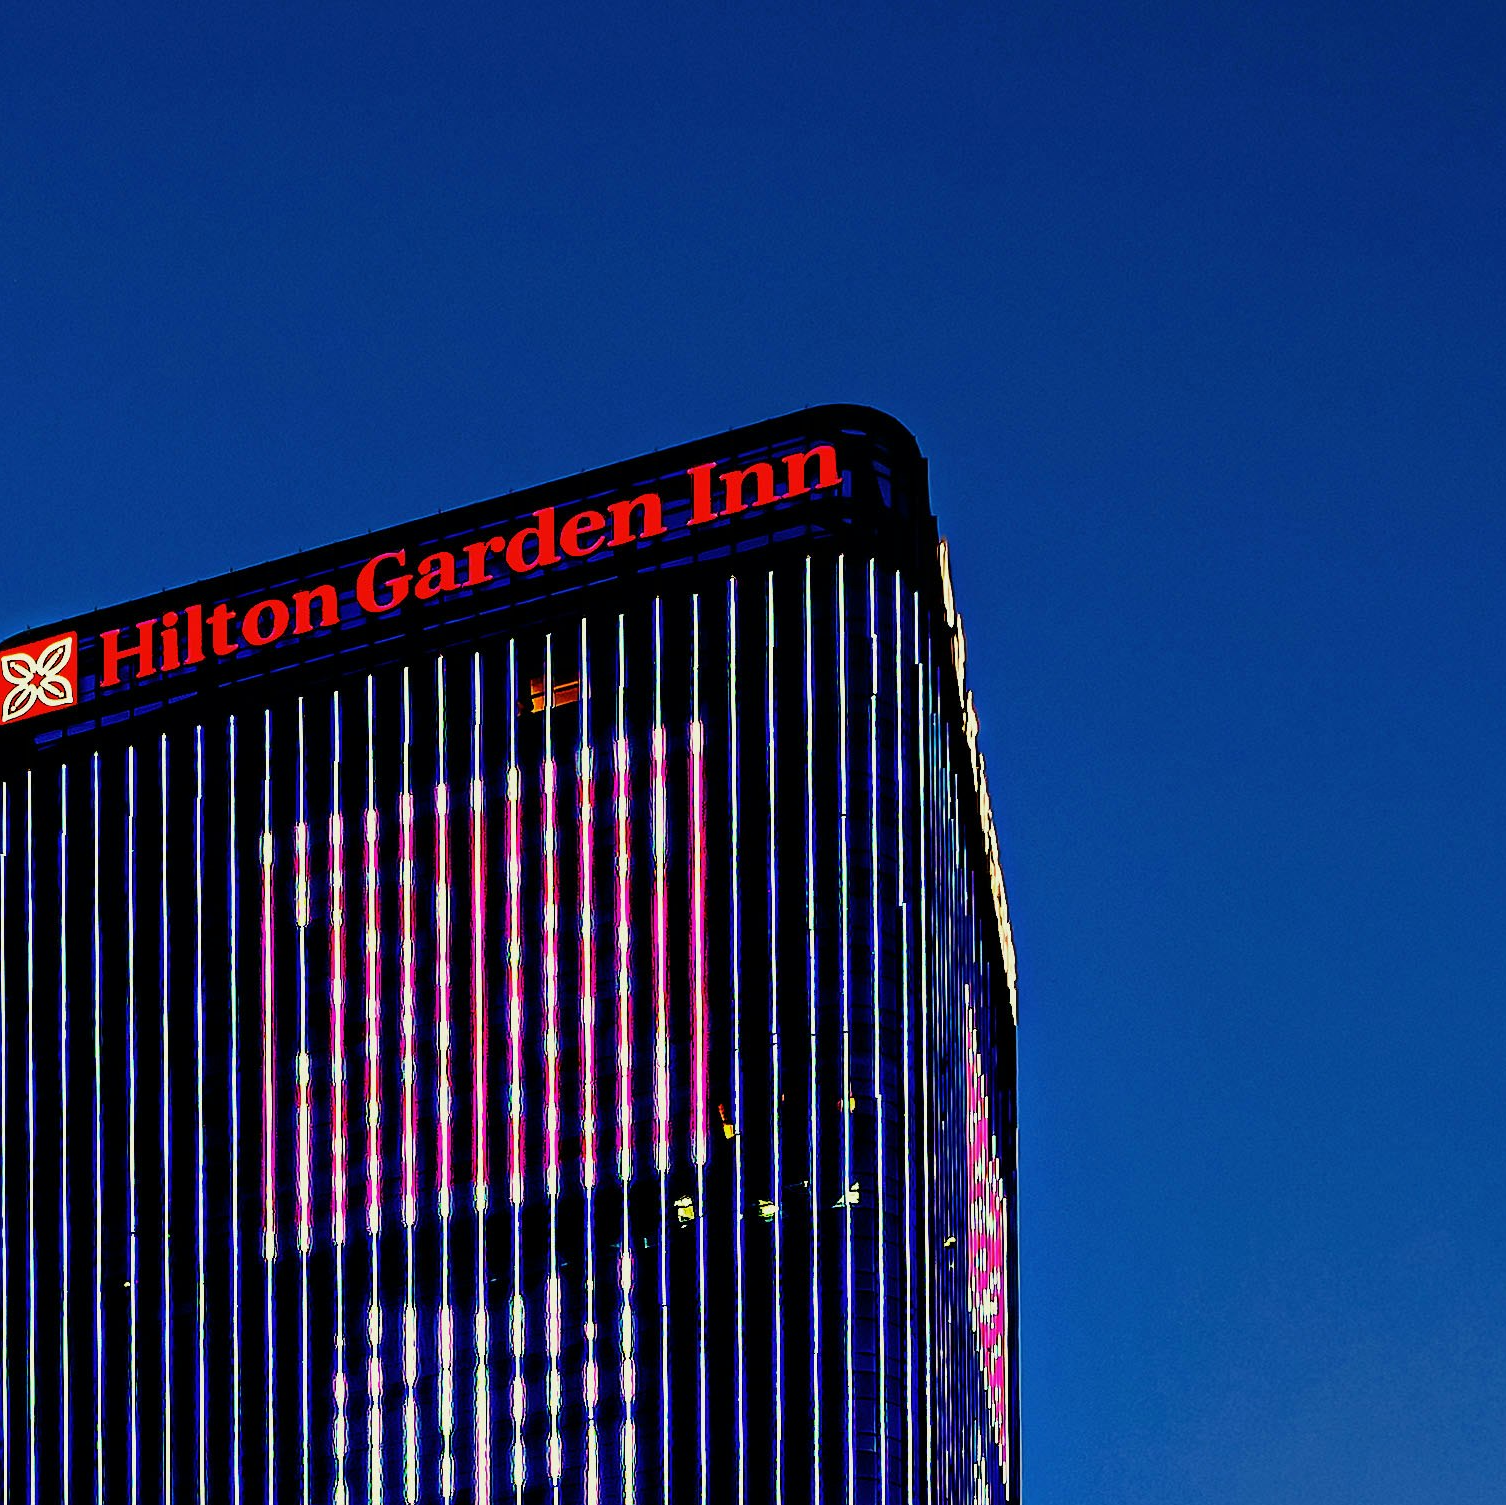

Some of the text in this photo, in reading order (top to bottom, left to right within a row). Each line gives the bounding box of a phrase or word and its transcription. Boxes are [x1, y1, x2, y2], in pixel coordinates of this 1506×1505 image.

[100, 445, 842, 687] Hilton Garden Inn
